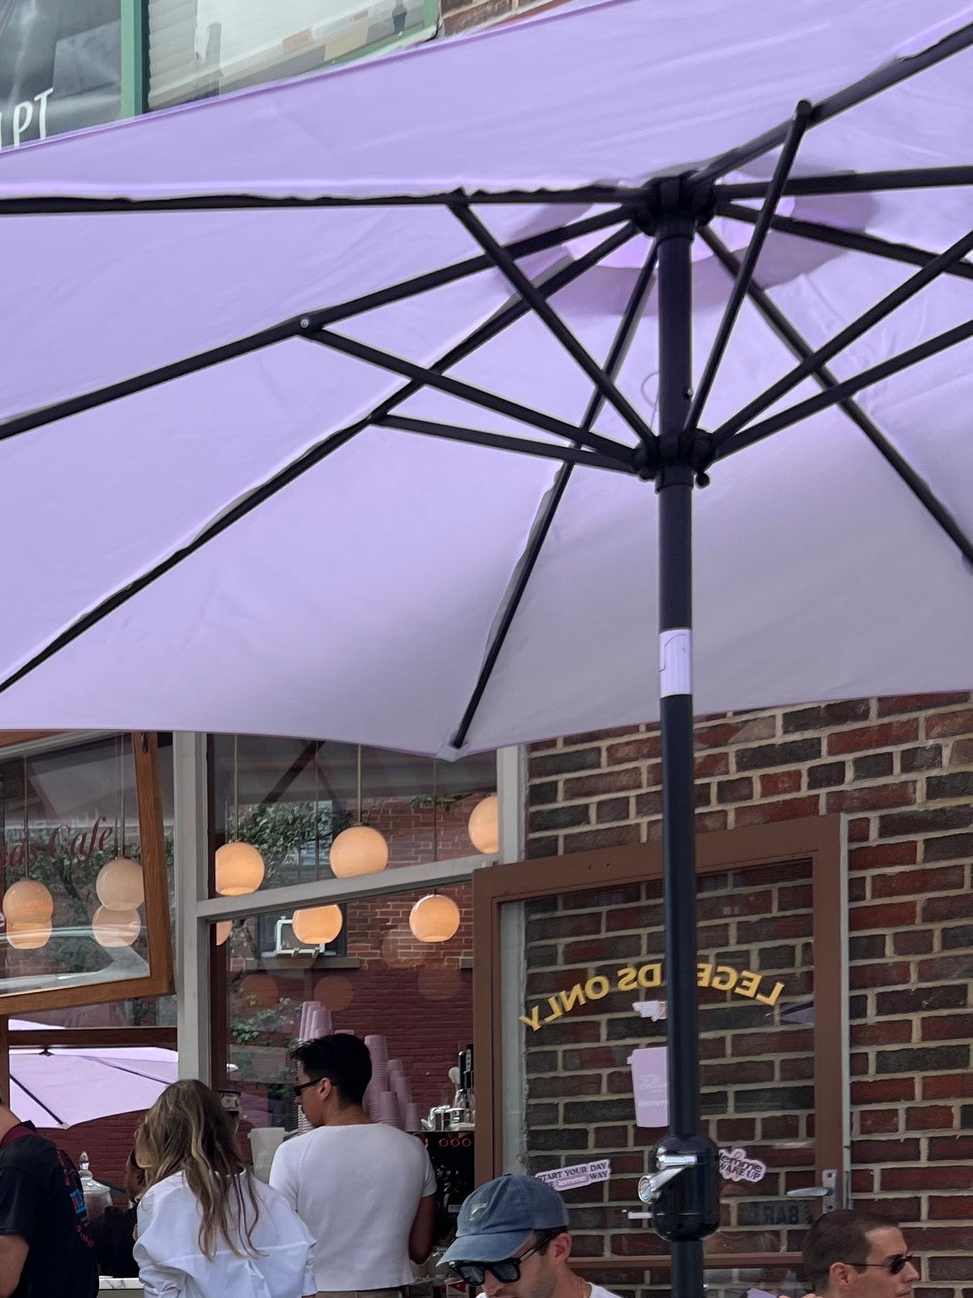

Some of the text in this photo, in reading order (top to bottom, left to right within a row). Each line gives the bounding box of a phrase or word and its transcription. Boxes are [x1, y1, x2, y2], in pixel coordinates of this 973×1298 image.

[564, 1166, 588, 1177] YOUR
[590, 1162, 608, 1172] DAY
[589, 1171, 608, 1180] WAY
[746, 1170, 761, 1180] UP
